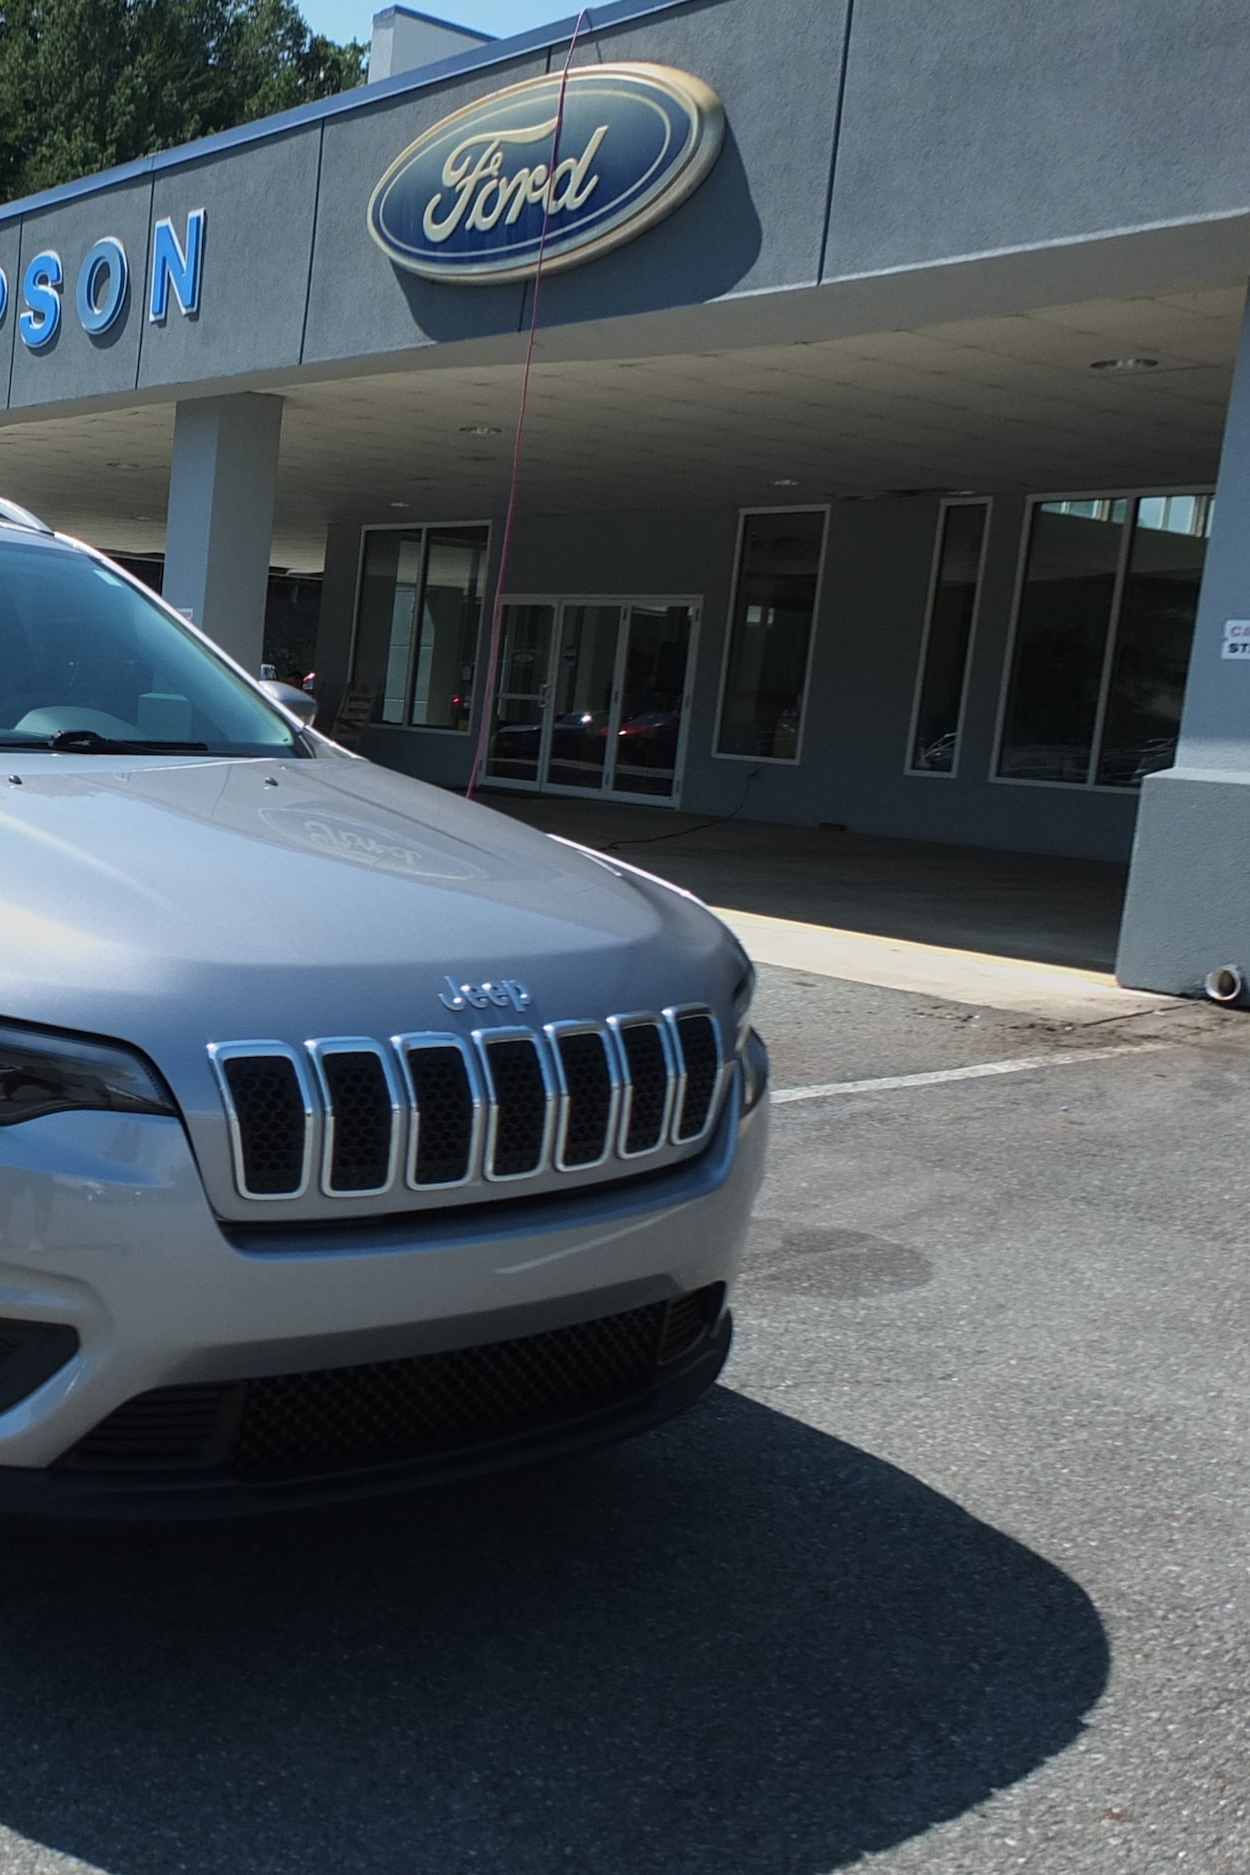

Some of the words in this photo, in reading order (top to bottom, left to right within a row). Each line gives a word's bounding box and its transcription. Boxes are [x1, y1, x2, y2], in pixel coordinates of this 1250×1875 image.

[422, 117, 609, 243] Ford
[1228, 642, 1250, 654] ST
[437, 975, 532, 1013] Jeep
